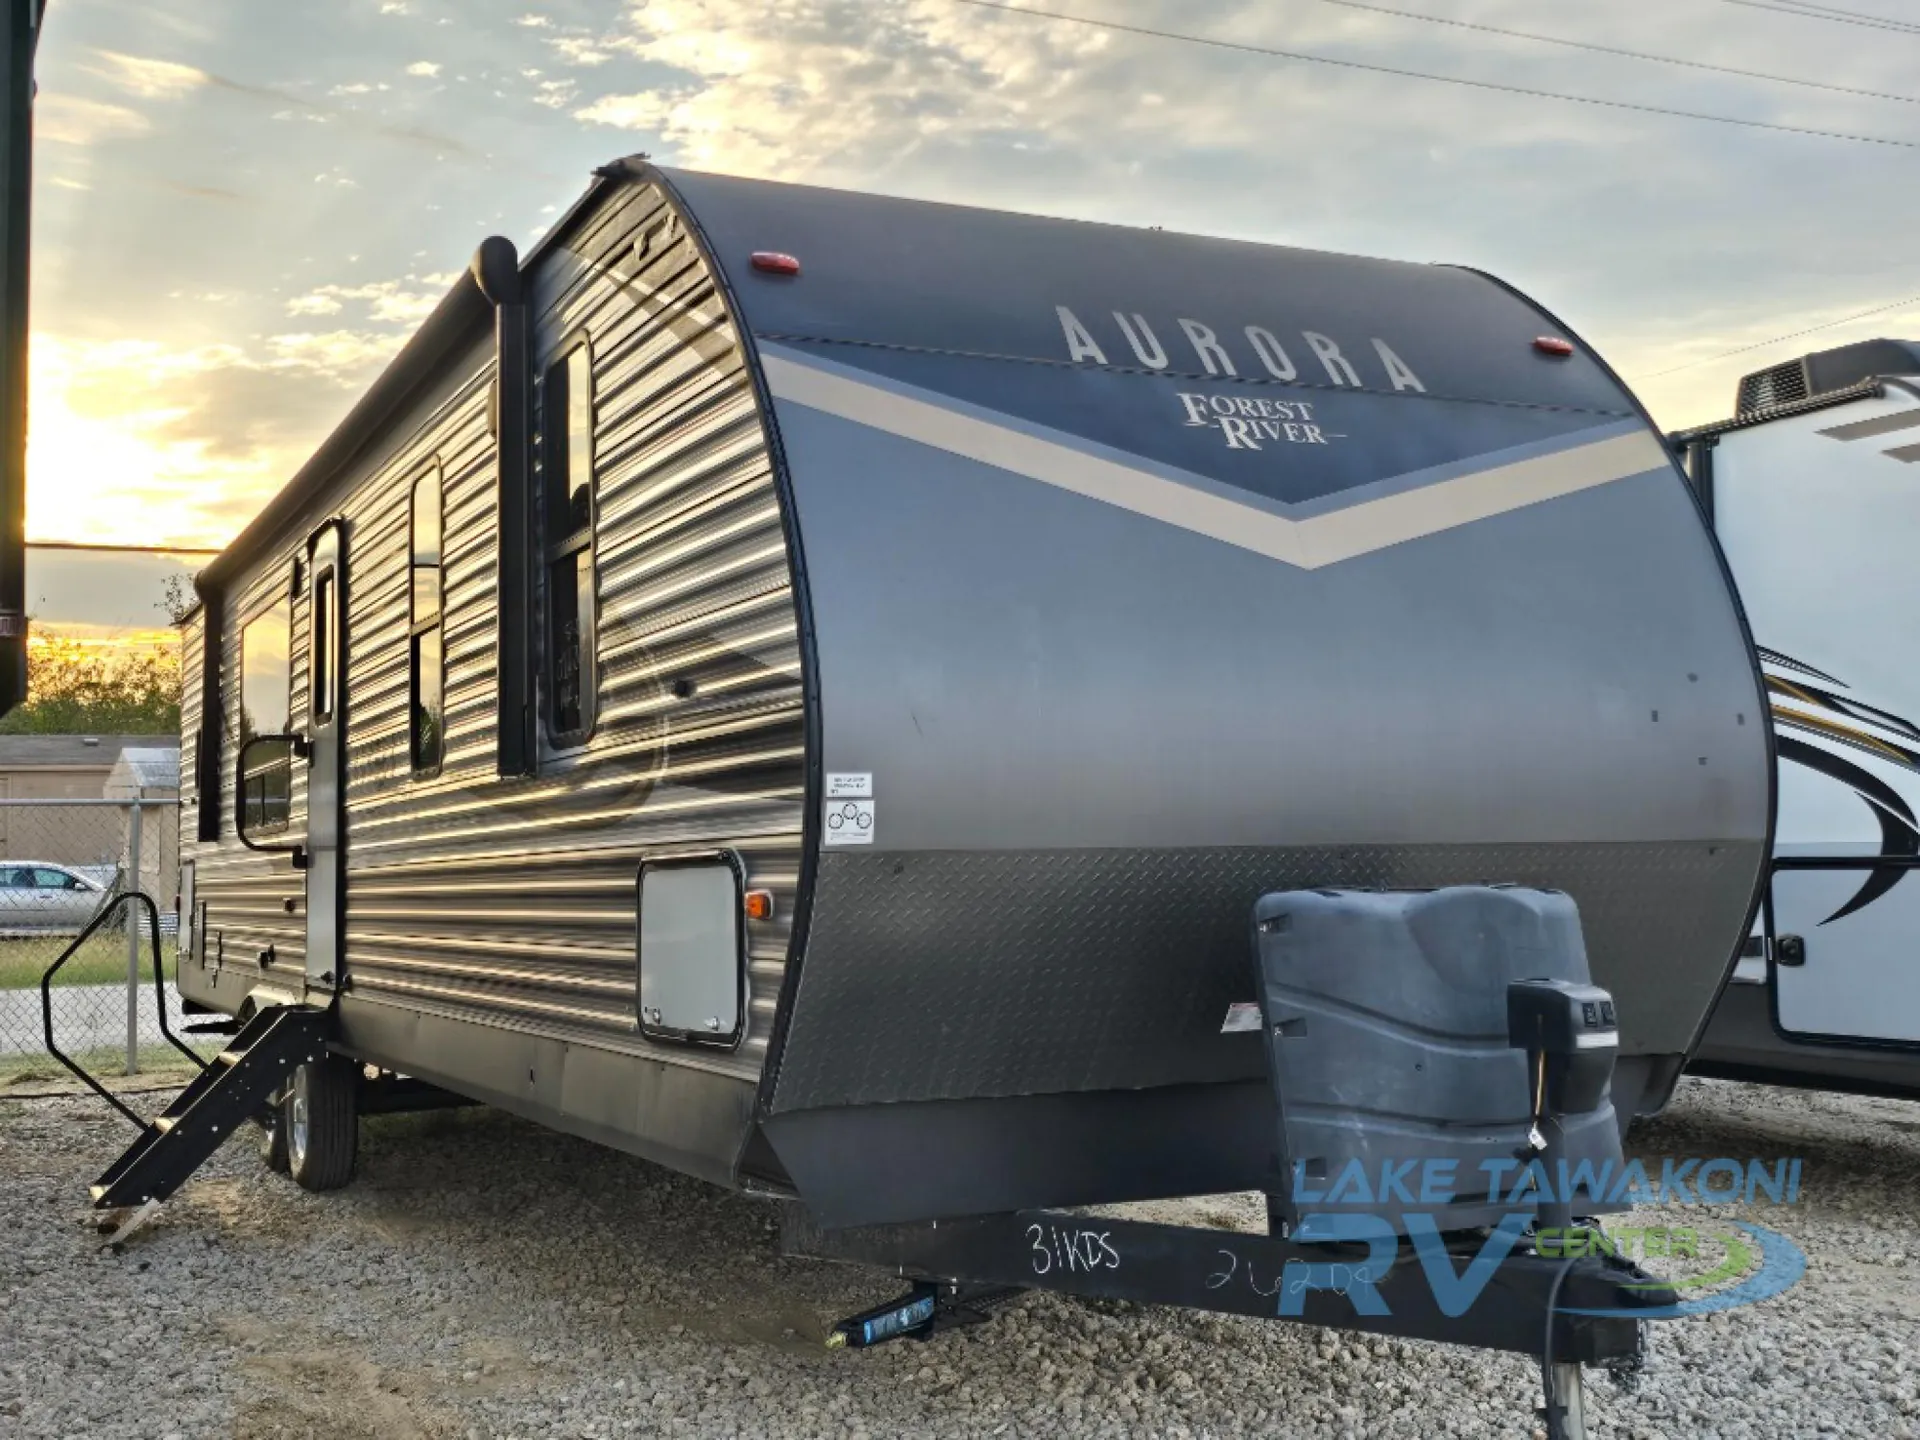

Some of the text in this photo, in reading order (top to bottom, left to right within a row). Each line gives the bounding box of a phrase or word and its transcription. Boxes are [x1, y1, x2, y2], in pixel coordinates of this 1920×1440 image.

[1055, 304, 1427, 393] AURORA
[1176, 392, 1314, 427] FOREST
[1212, 415, 1329, 451] RIVER
[1026, 1223, 1120, 1274] 31KDS
